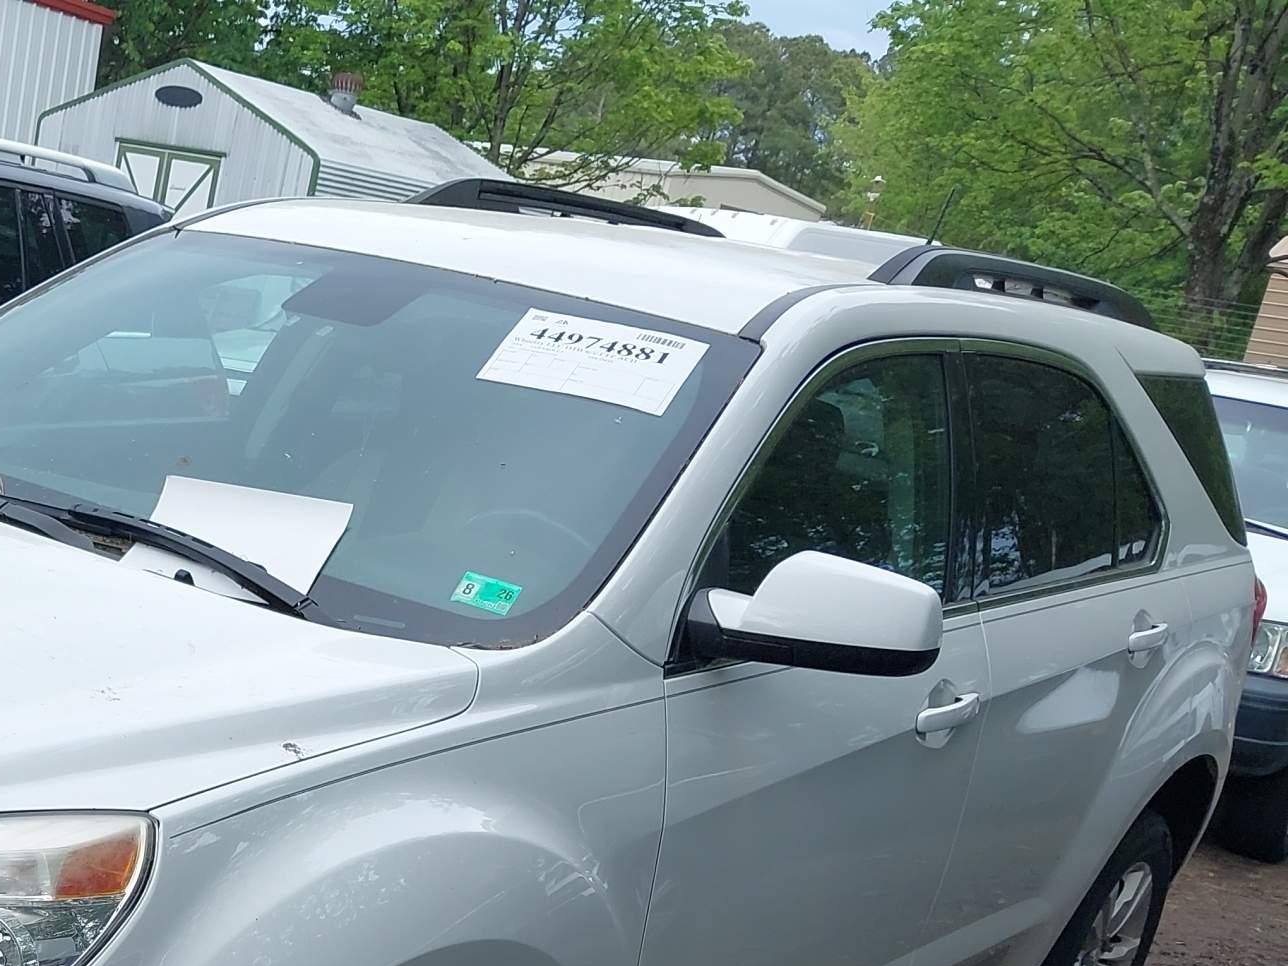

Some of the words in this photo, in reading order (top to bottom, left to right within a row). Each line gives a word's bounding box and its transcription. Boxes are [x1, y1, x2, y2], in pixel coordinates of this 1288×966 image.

[529, 327, 670, 365] 44974881
[462, 582, 475, 595] 8
[497, 588, 514, 601] 26
